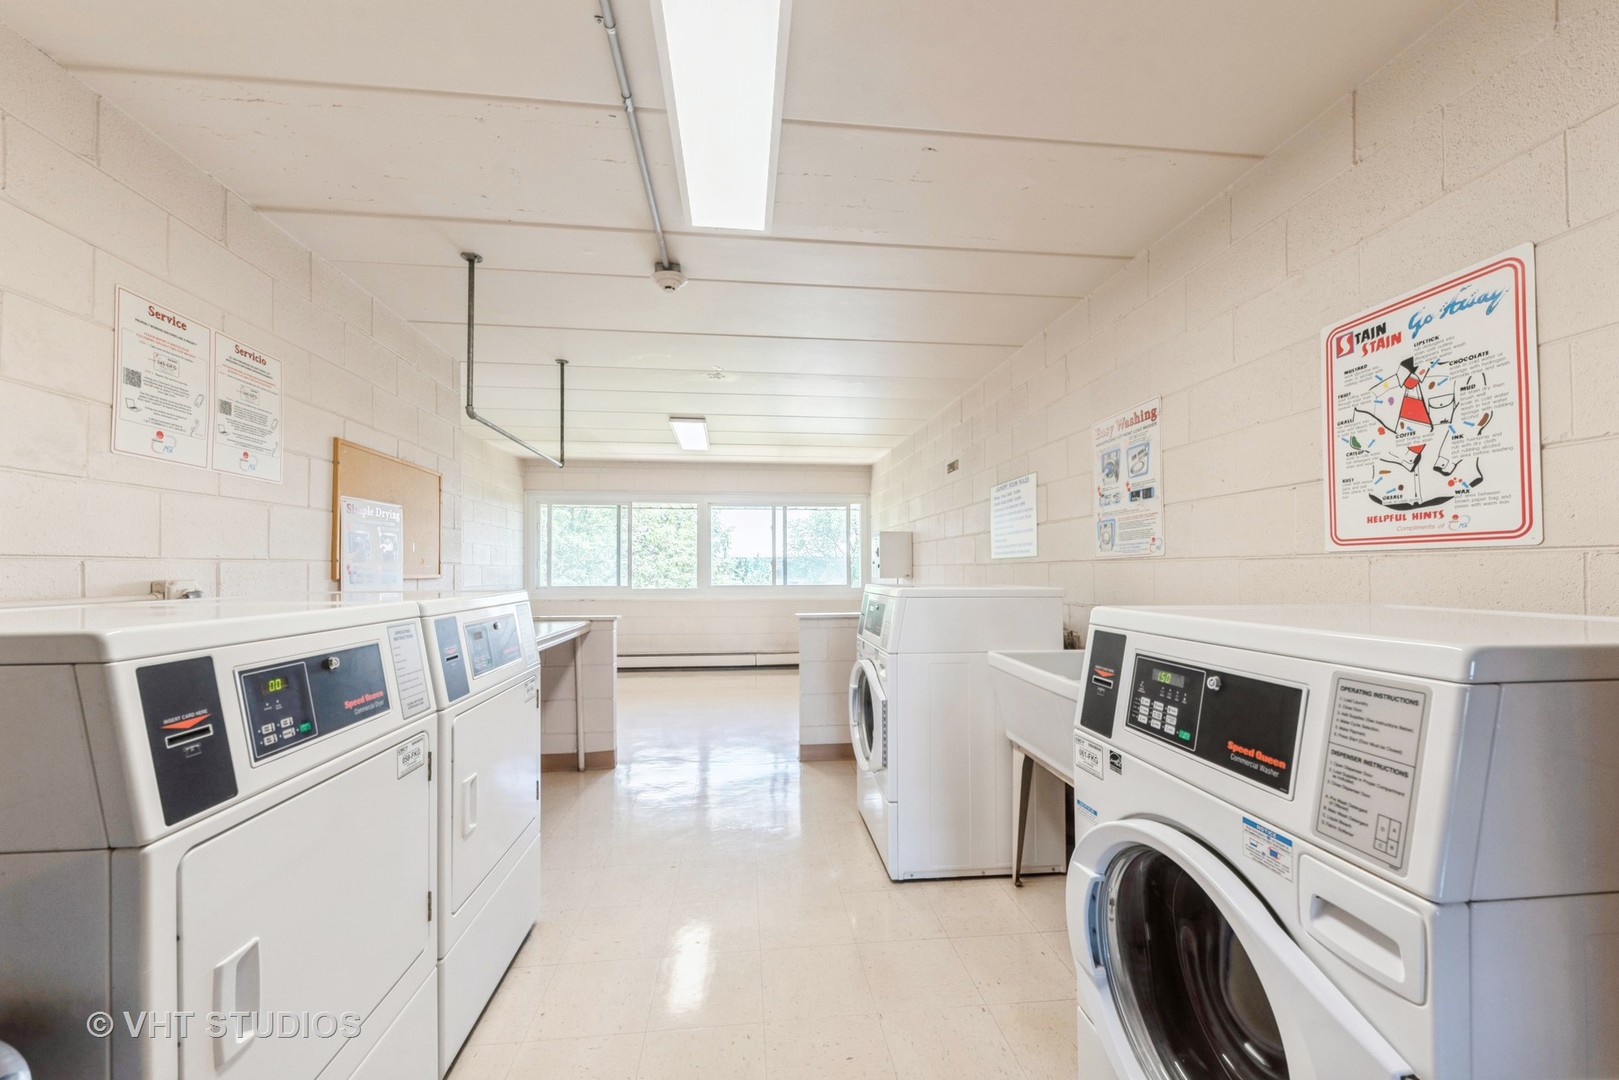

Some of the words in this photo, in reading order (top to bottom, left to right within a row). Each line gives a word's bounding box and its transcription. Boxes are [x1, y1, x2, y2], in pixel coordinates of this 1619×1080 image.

[148, 305, 187, 331] Service
[1408, 311, 1433, 339] Go
[1439, 287, 1505, 319] Away
[1362, 331, 1402, 357] STAIN
[1413, 335, 1439, 347] LIPSTICK
[235, 344, 267, 366] Servicio
[1449, 350, 1489, 366] CHOCOLATE
[1344, 364, 1367, 375] MUSTARD
[1460, 383, 1476, 391] MUD
[1114, 407, 1158, 432] Washing
[1396, 431, 1416, 439] COFFEE
[346, 503, 374, 519] Simple
[375, 507, 401, 523] Drying
[1366, 513, 1407, 524] HELPFUL
[1411, 509, 1445, 521] HINTS
[1396, 524, 1436, 532] Compliments
[344, 695, 365, 710] Speed
[365, 690, 384, 702] Queen
[1340, 685, 1372, 697] OPERATING
[1373, 692, 1419, 707] INSTRUCTIONS
[163, 715, 181, 725] INSERT
[181, 711, 195, 720] CARD
[195, 708, 208, 716] HERE
[354, 703, 375, 716] Commercial
[375, 699, 385, 709] Dryer
[1227, 740, 1255, 757] Speed
[1255, 750, 1287, 770] Queen
[1230, 753, 1258, 770] Commercial
[1259, 764, 1280, 777] Washer
[1330, 749, 1362, 763] DISPENSER
[1363, 759, 1409, 778] INSTRUCTIONS
[1256, 824, 1277, 839] NOTICE
